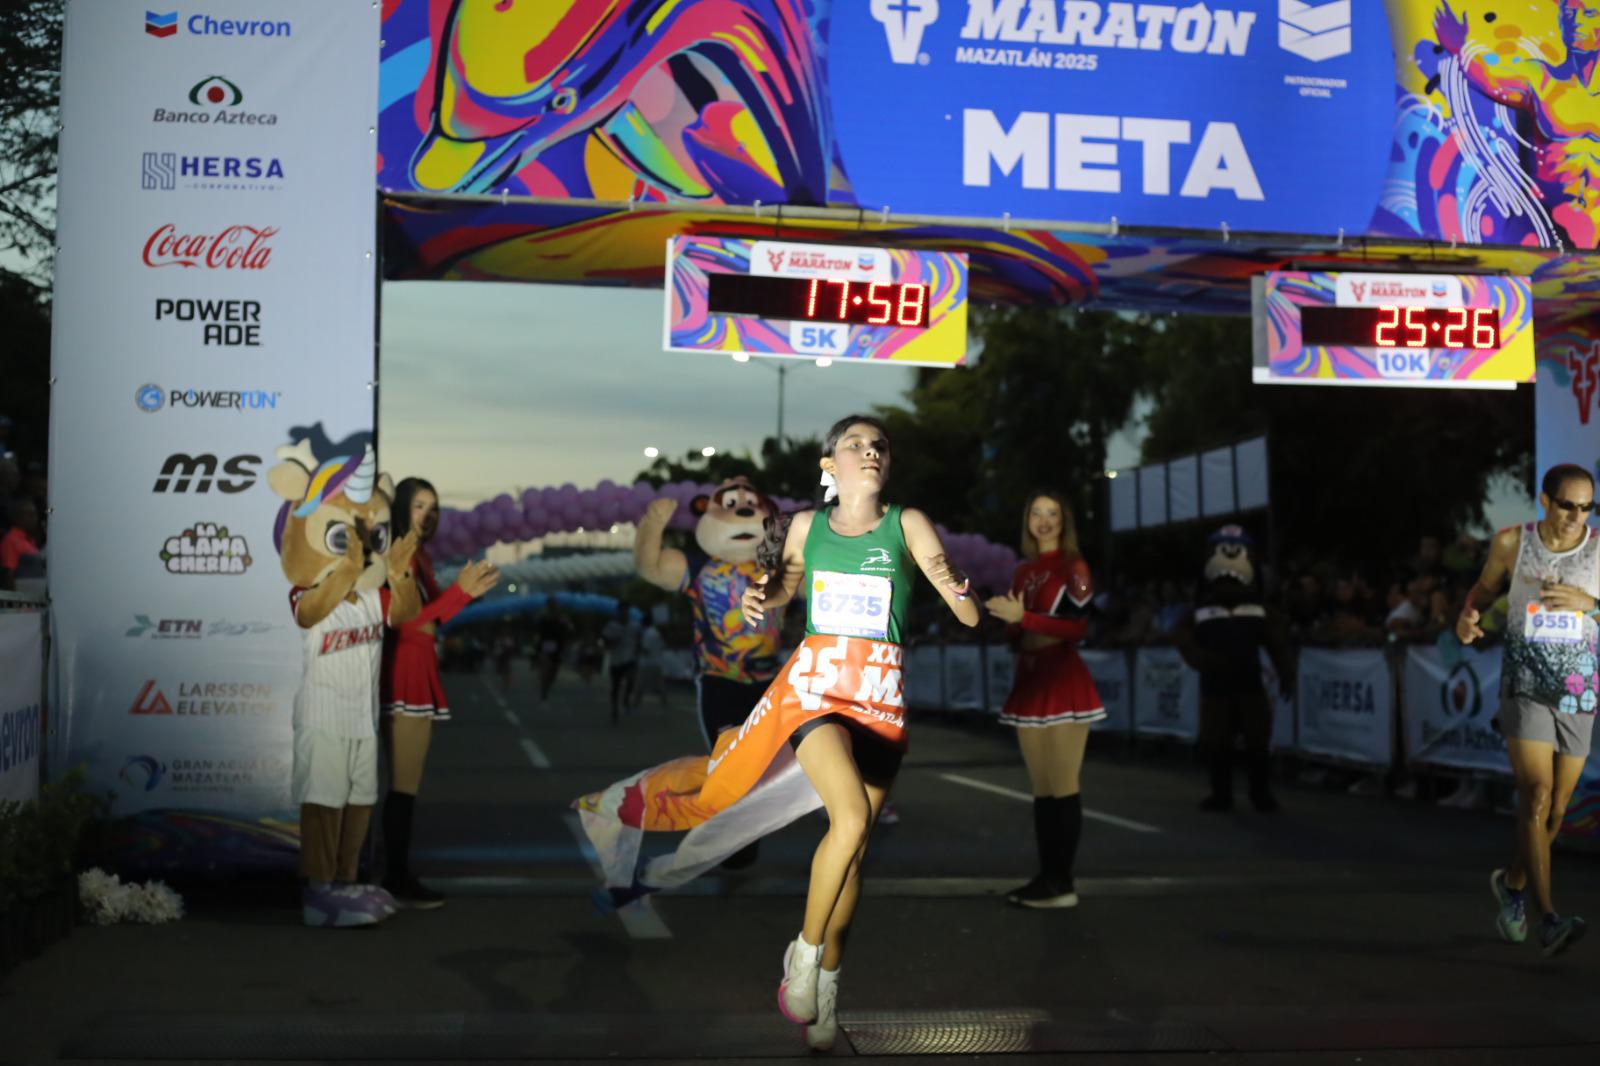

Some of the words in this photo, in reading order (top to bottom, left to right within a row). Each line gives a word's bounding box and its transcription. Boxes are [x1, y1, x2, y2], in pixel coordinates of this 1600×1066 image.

[187, 13, 291, 37] Chevron
[956, 46, 1052, 70] MAZATLÁN
[1053, 51, 1098, 71] 2025
[153, 107, 210, 124] Banco
[213, 109, 277, 126] Azteca
[962, 107, 1266, 201] META
[181, 156, 284, 179] HERSA
[156, 298, 261, 323] POWER
[203, 324, 261, 346] ADE
[800, 327, 837, 349] 5K
[1380, 352, 1425, 373] 10K
[195, 523, 217, 537] LA
[165, 536, 248, 556] CLAMA
[818, 592, 882, 617] 6735
[158, 619, 203, 633] ETN
[1532, 613, 1577, 630] 6551
[179, 682, 273, 698] LARSSON
[1320, 680, 1375, 715] HERSA
